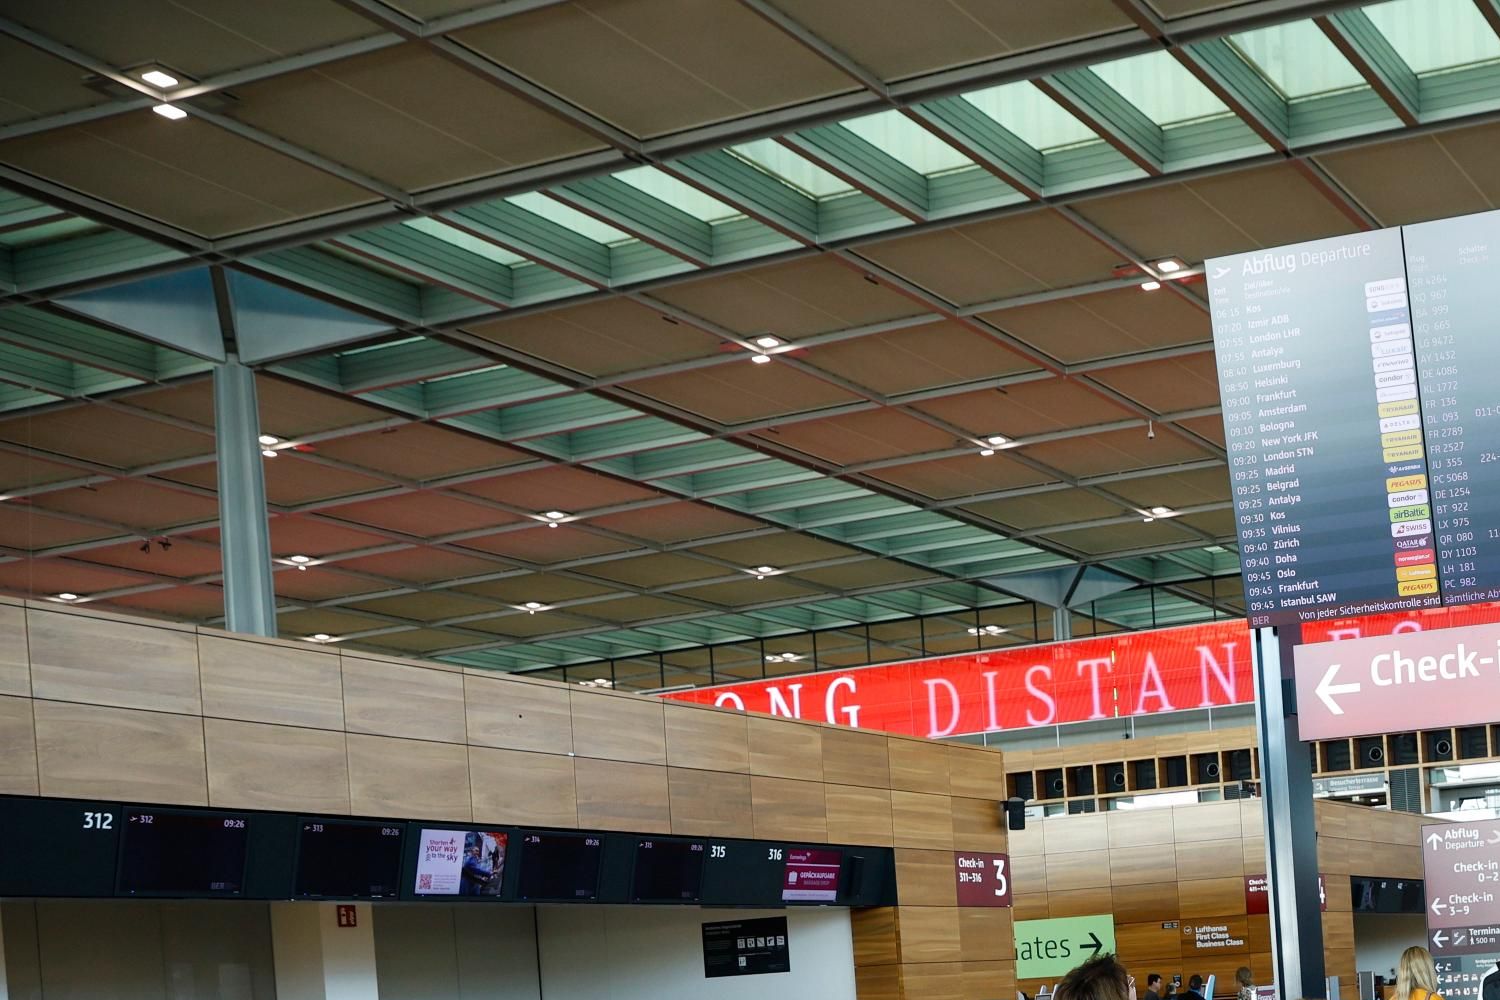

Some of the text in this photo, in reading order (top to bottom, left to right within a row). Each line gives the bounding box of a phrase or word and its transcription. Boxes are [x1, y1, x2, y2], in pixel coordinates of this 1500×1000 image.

[1240, 241, 1371, 280] Abflug Departure
[1241, 506, 1425, 539] 09:35 Vilnius airBaltic
[1245, 556, 1269, 568] 09:40
[1275, 553, 1297, 564] Doha
[1439, 534, 1452, 544] QR
[1456, 531, 1473, 542] 080
[1250, 592, 1337, 610] 09:45 Istanbul SAW
[1252, 615, 1269, 625] BER
[1298, 609, 1315, 620] Von
[1315, 607, 1338, 620] jeder
[1339, 596, 1421, 615] Sicherheitskontrolle
[1422, 594, 1440, 606] sind
[1444, 590, 1485, 604] sämtliche
[83, 812, 113, 829] 312
[139, 815, 245, 828] 312 09:26
[312, 824, 400, 836] 313 09:26
[1444, 828, 1479, 840] Abflug
[426, 845, 458, 854] your way
[1445, 839, 1485, 850] Departure
[446, 854, 458, 863] sky
[710, 845, 782, 861] 315 316
[1453, 860, 1498, 873] Check-in
[958, 857, 1007, 897] Check-in 3
[959, 872, 982, 883] 311–316
[1478, 872, 1499, 883] 0–2
[1448, 892, 1493, 904] Check-in
[1449, 905, 1470, 916] 3–9
[1195, 925, 1228, 934] Lufthansa
[1195, 932, 1229, 941] First Class
[1196, 940, 1225, 948] Business
